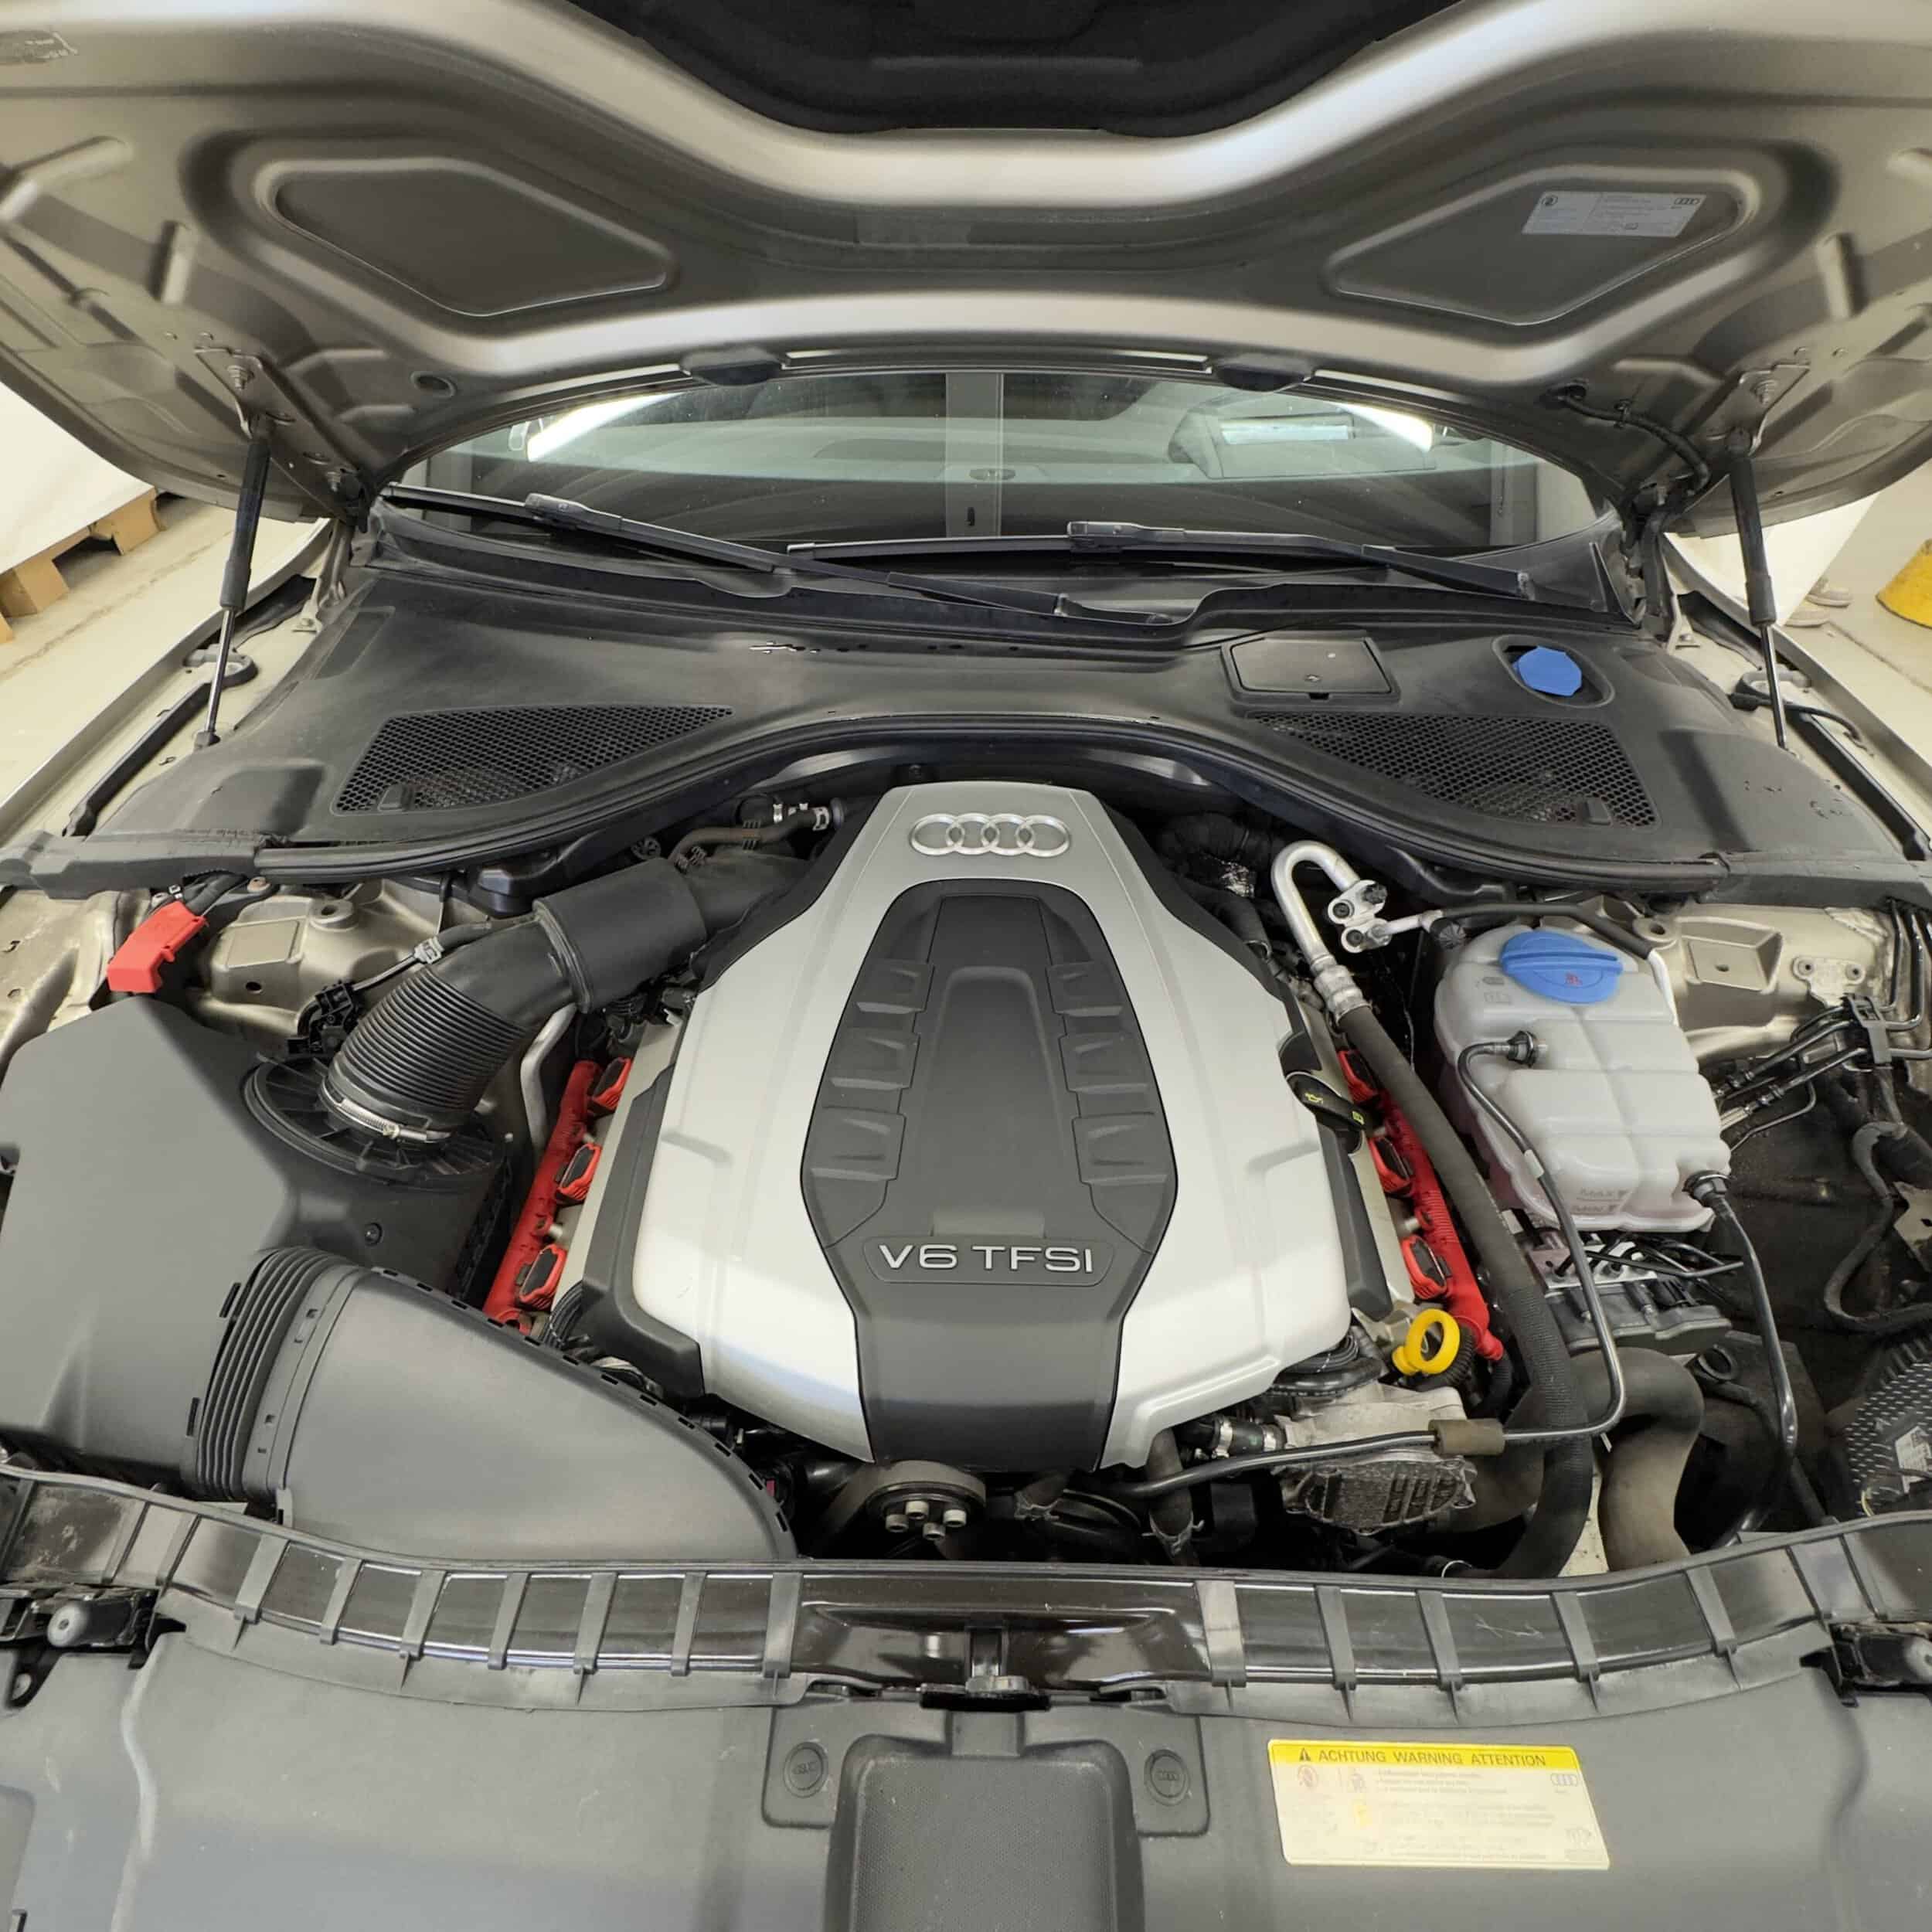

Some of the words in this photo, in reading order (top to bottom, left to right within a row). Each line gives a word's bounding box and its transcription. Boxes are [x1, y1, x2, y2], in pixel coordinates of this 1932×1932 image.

[878, 1243, 958, 1270] V6
[971, 1245, 1094, 1274] TFSI
[1318, 1749, 1386, 1763] ACHTUNG
[1393, 1750, 1463, 1765] WARNING
[1471, 1753, 1546, 1767] ATTENTION
